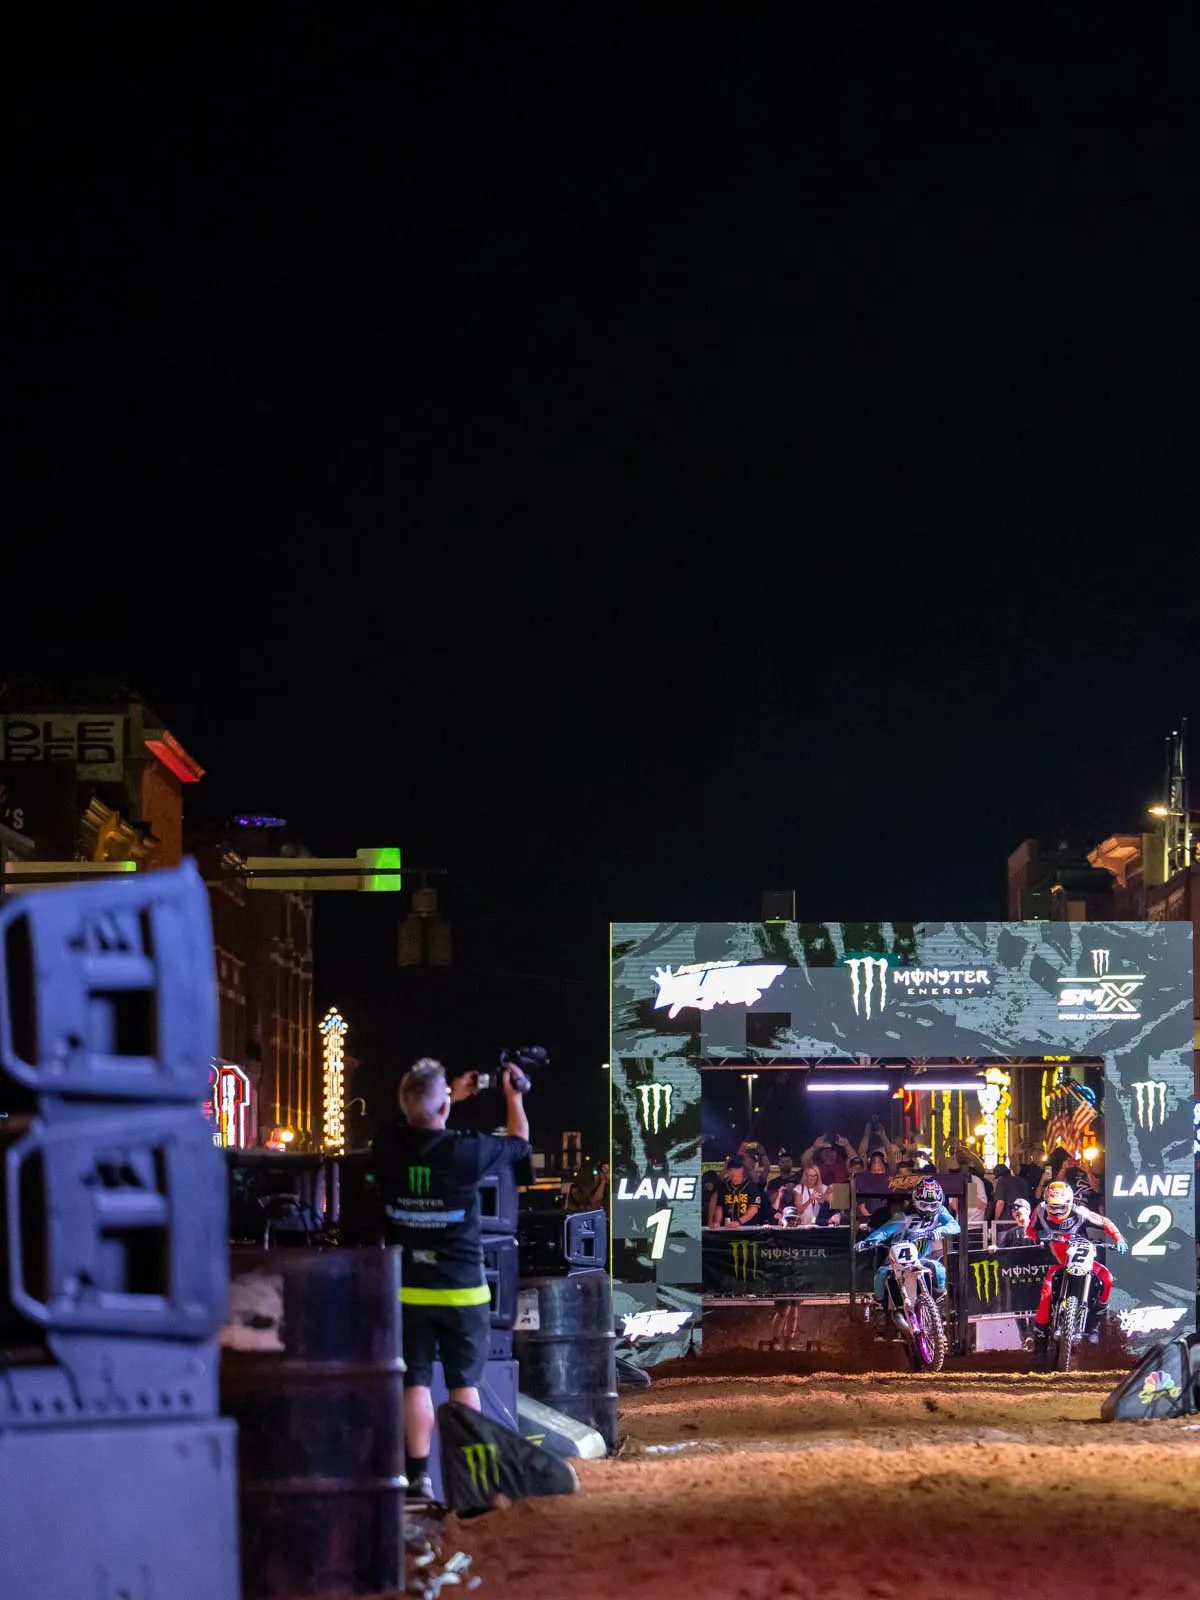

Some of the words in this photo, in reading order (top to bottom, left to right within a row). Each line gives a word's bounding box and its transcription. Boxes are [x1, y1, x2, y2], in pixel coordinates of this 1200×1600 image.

[893, 967, 991, 987] MONSTER
[907, 987, 975, 995] ENERGY
[1057, 982, 1143, 1012] SMX
[617, 1177, 697, 1200] LANE
[1112, 1173, 1192, 1197] LANE
[645, 1208, 672, 1260] 1
[1131, 1204, 1173, 1256] 2
[760, 1247, 827, 1259] MONSTER
[897, 1247, 912, 1261] 4
[1071, 1248, 1089, 1263] 2
